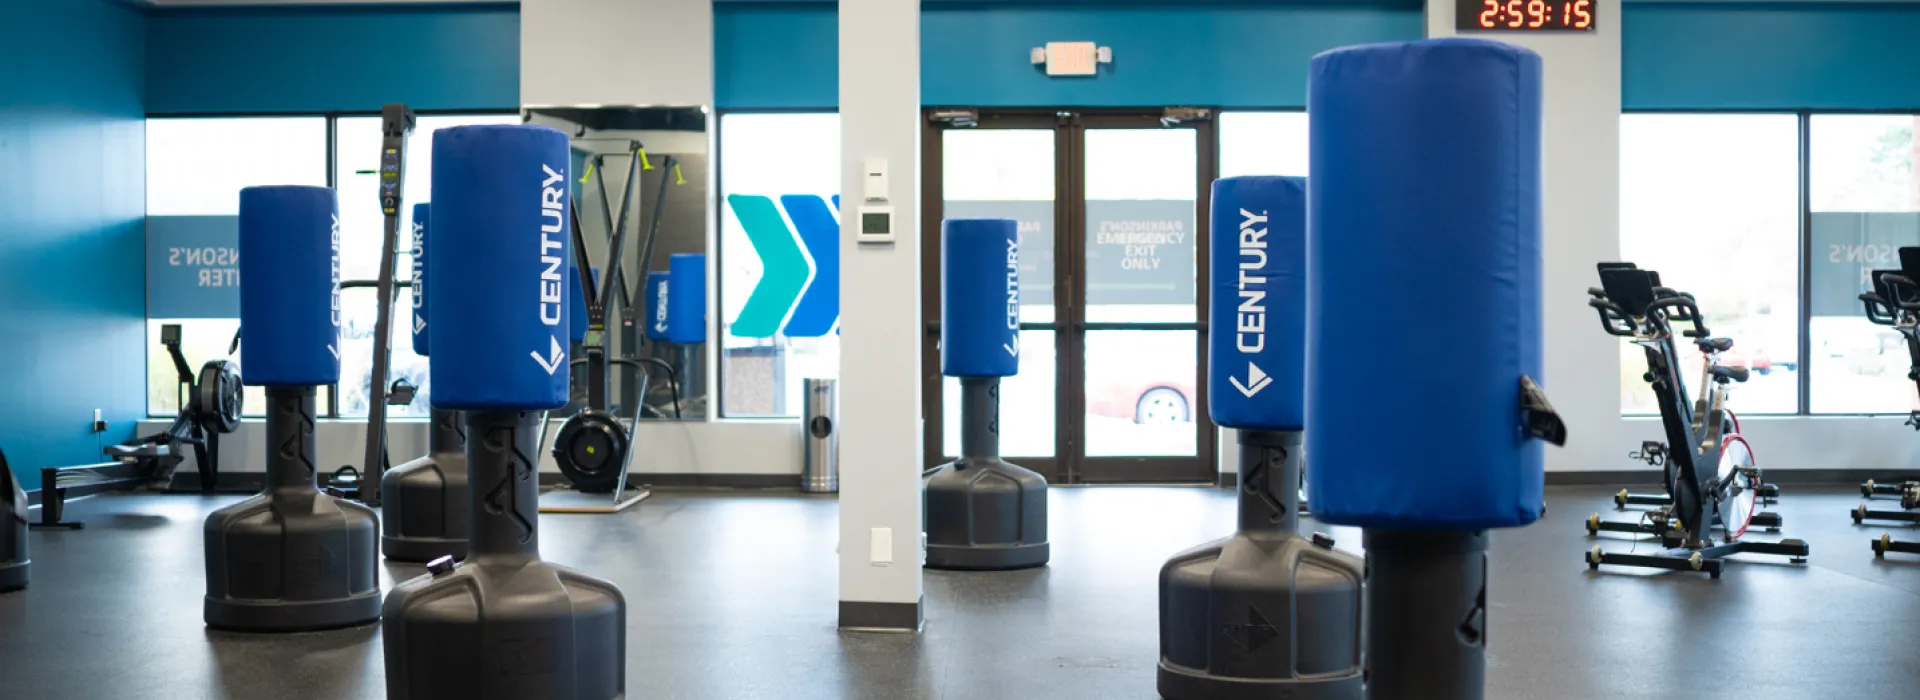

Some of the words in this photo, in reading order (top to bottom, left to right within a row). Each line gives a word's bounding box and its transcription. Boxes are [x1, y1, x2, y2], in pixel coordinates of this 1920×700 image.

[1480, 0, 1591, 27] 2:59:15
[539, 163, 564, 326] CENTURY
[1096, 232, 1185, 244] EMERGENCY
[1125, 245, 1157, 257] EXIT
[1121, 257, 1161, 270] ONLY
[1006, 238, 1018, 330] CENTURY
[1236, 208, 1268, 353] CENTURY
